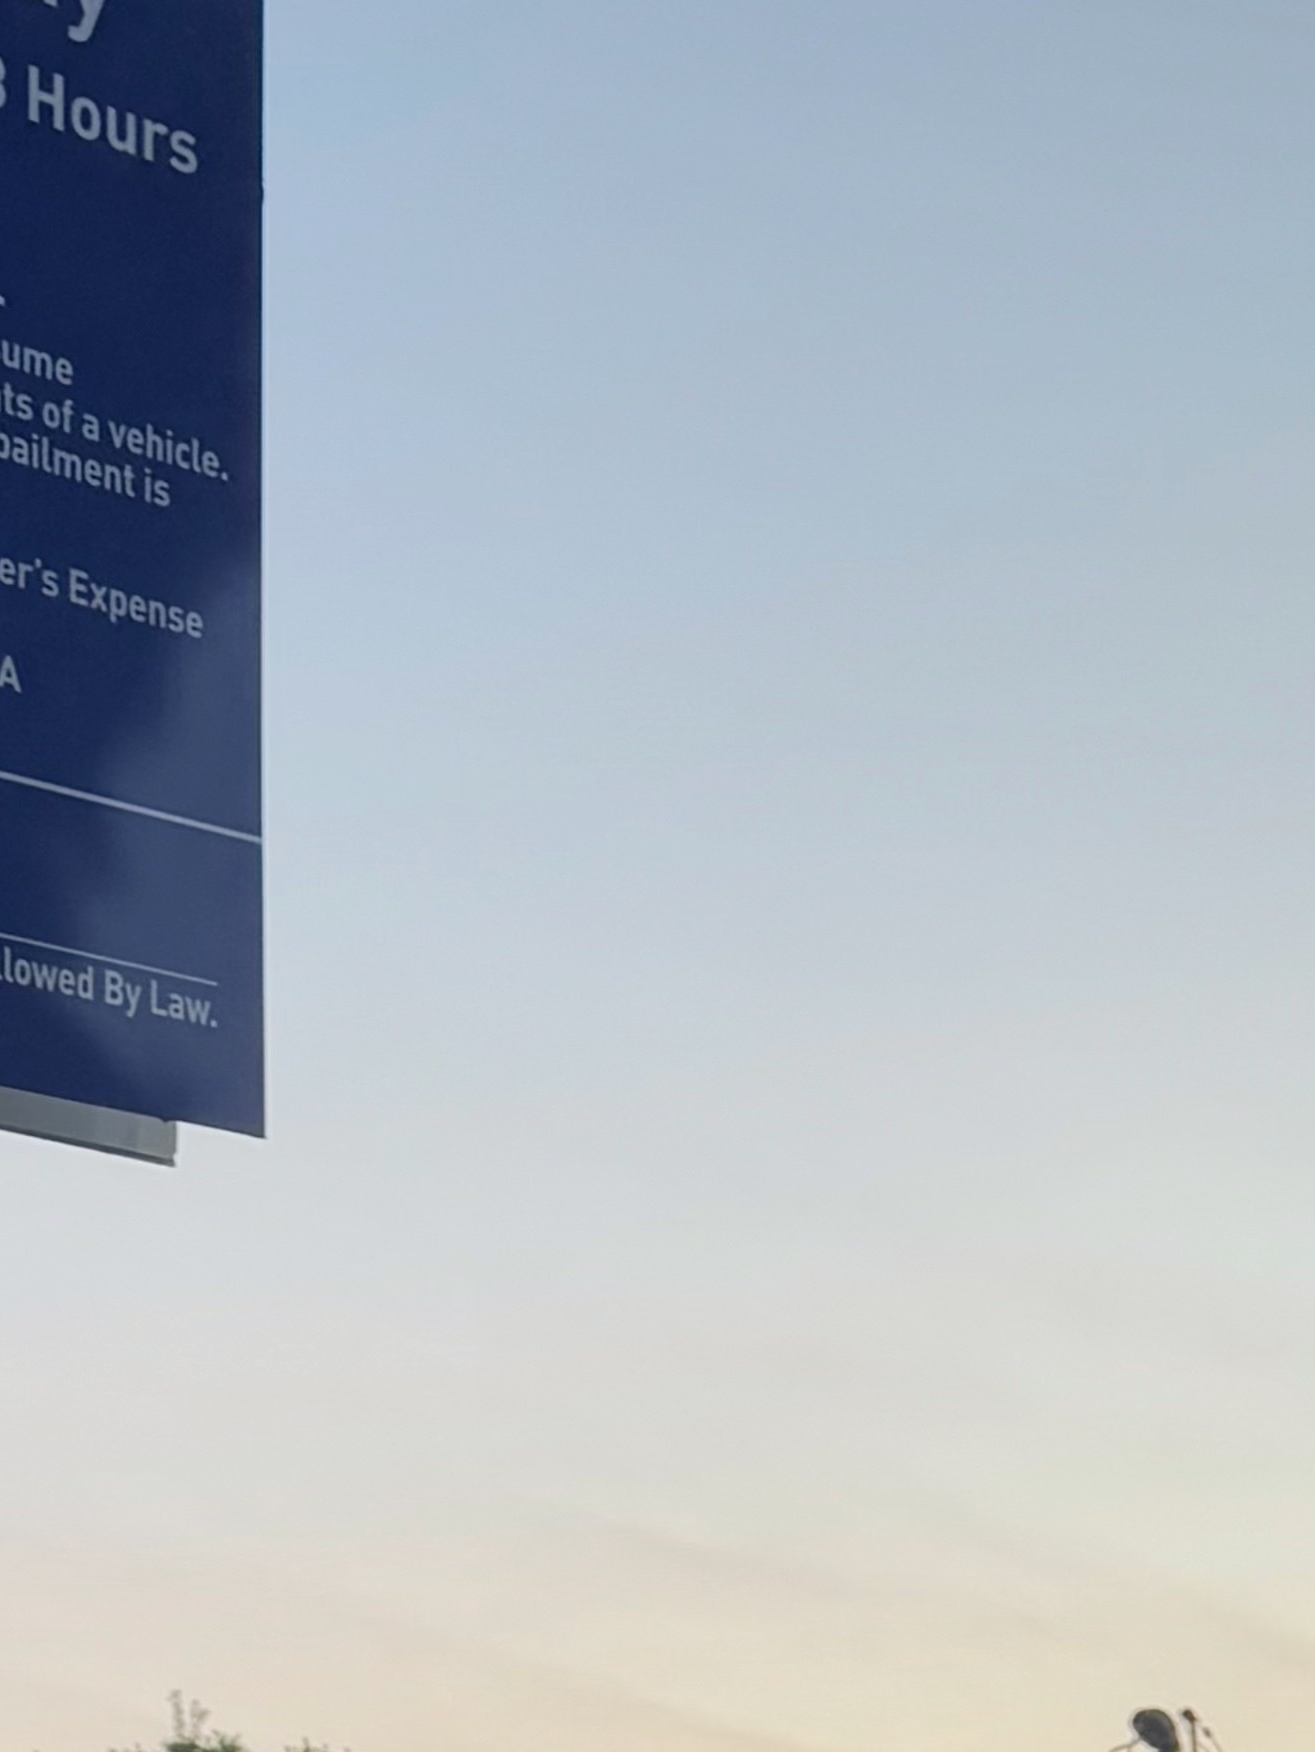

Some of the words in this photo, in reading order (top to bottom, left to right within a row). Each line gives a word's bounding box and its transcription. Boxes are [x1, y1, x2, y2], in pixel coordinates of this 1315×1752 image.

[27, 64, 199, 174] Hours
[41, 398, 75, 434] of
[81, 412, 100, 443] a
[107, 419, 229, 482] vehicle.
[143, 466, 171, 508] is
[68, 567, 204, 639] Expense
[103, 968, 143, 1019] By
[149, 978, 218, 1028] Law.
